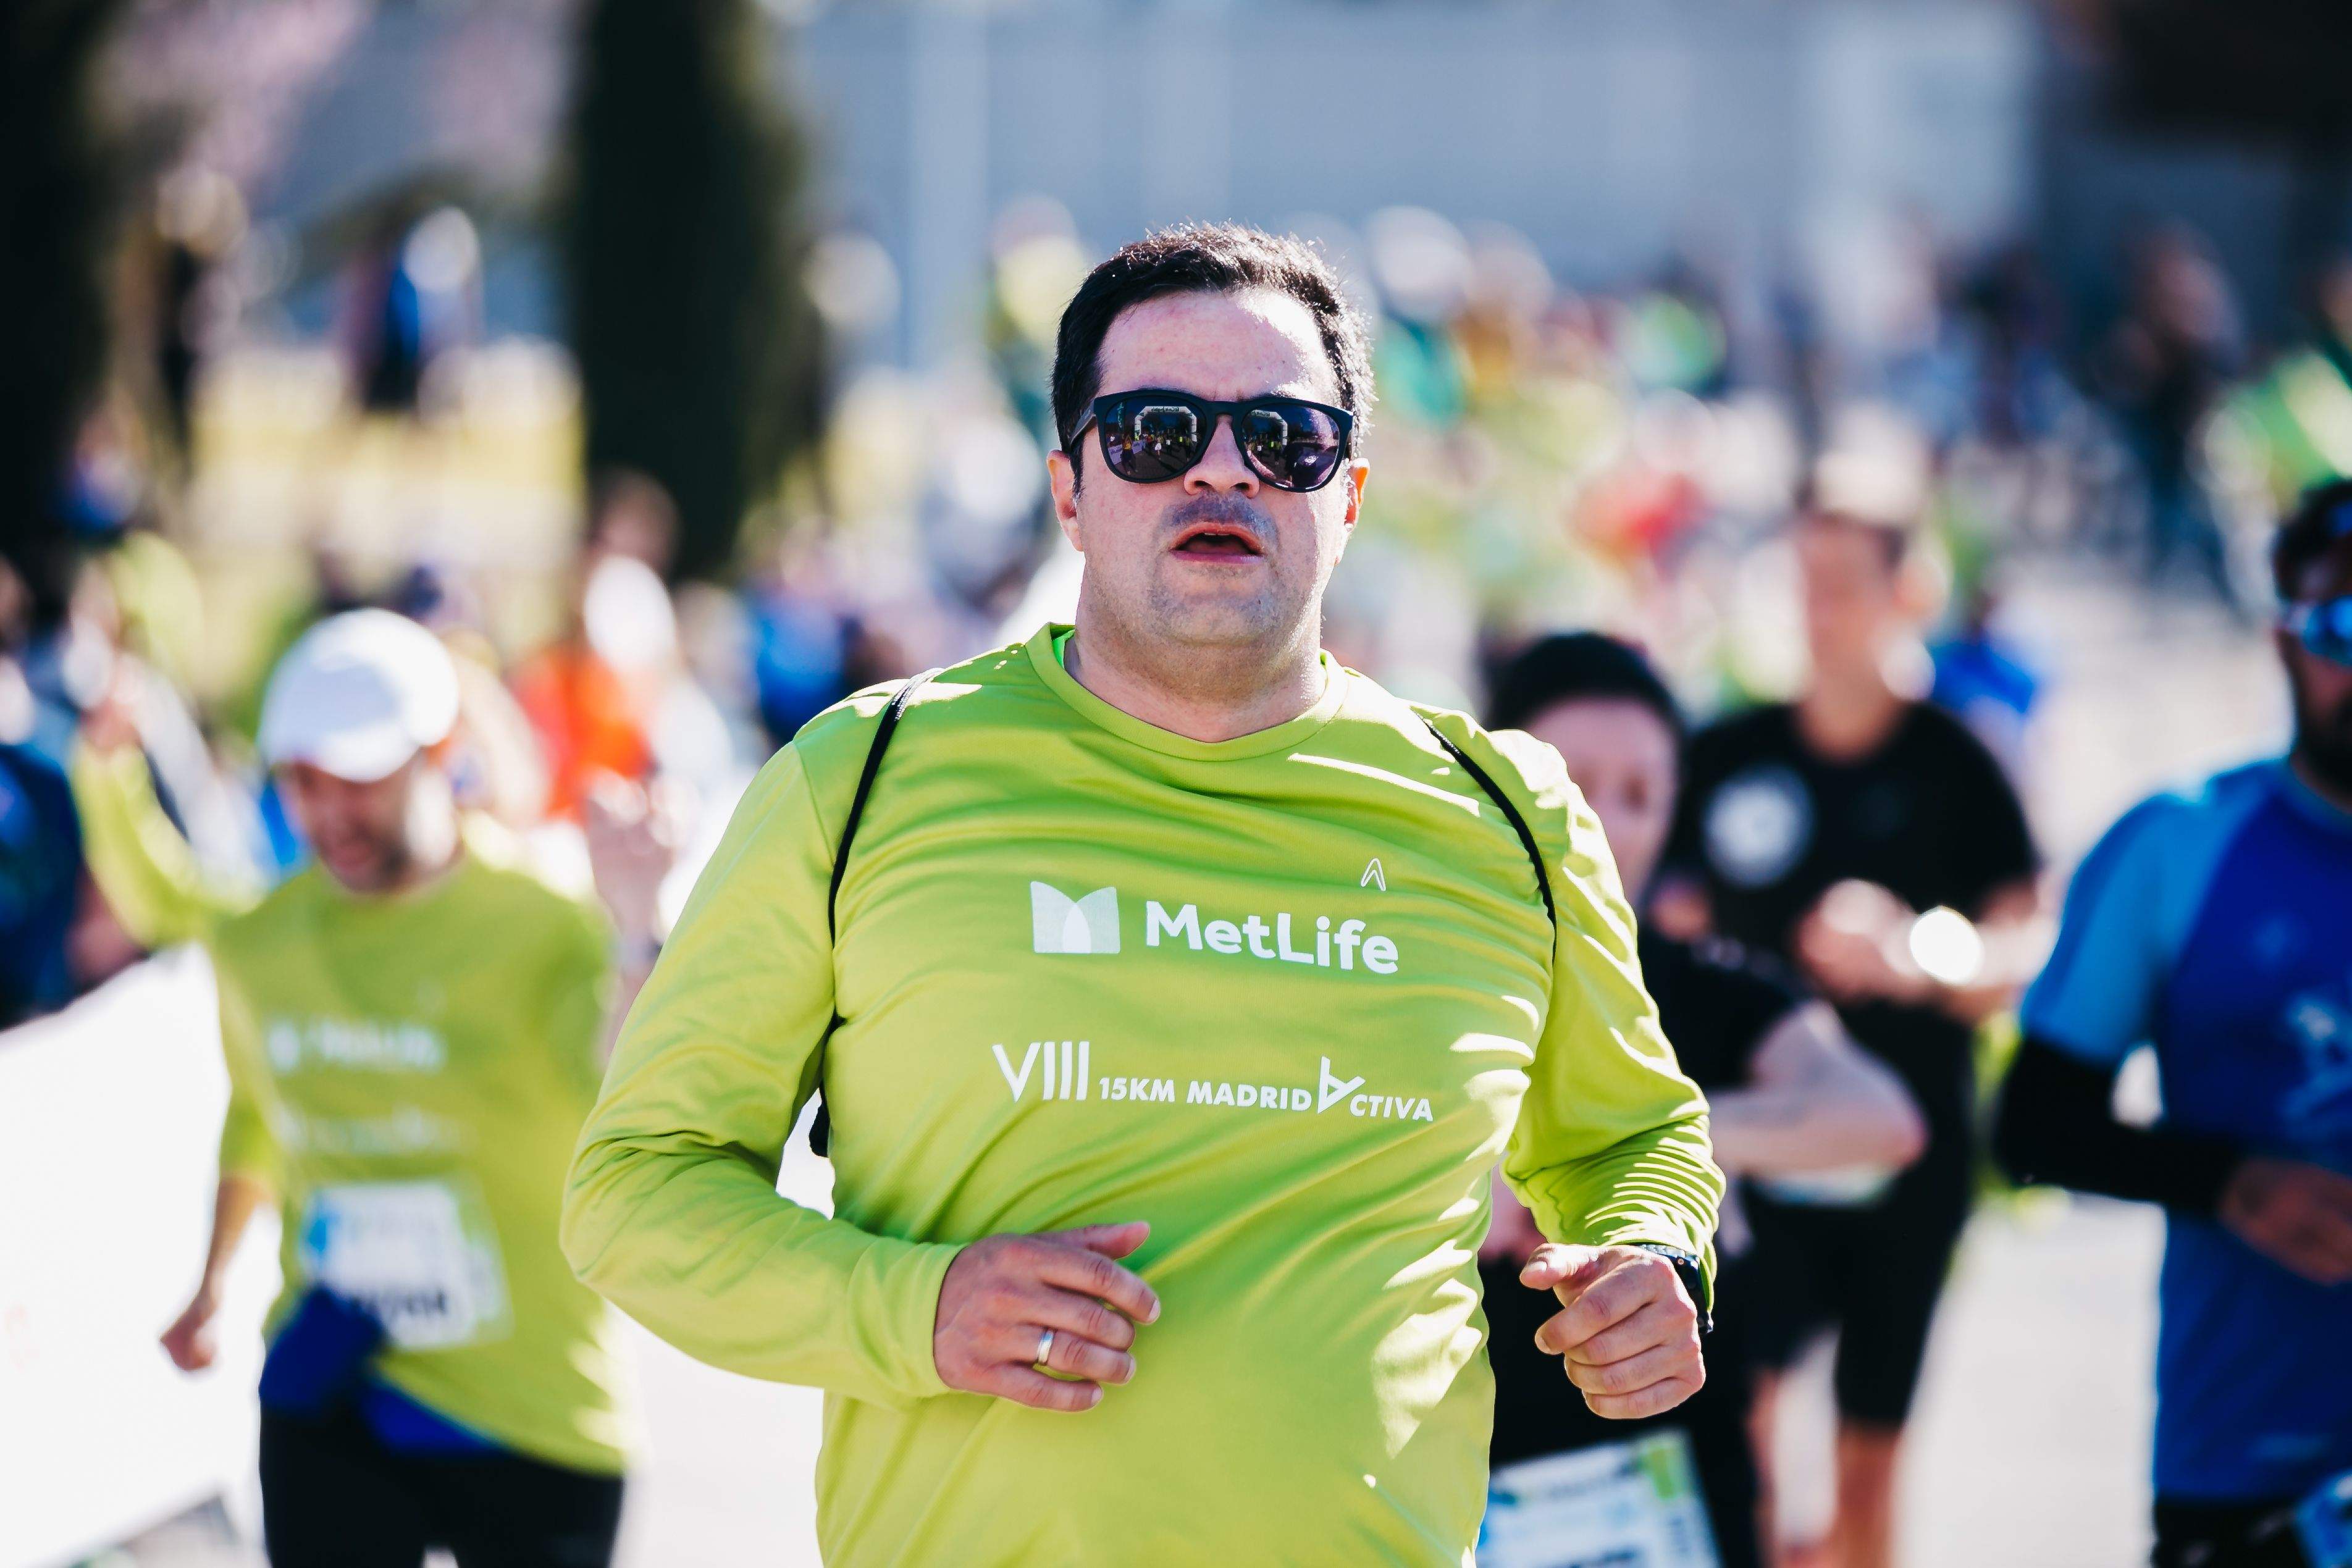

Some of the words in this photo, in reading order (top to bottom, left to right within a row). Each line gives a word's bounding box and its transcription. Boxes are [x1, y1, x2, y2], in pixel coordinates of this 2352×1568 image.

[1146, 900, 1398, 975] MetLife
[992, 1041, 1090, 1101] VIII
[1099, 1077, 1175, 1102] 15KM
